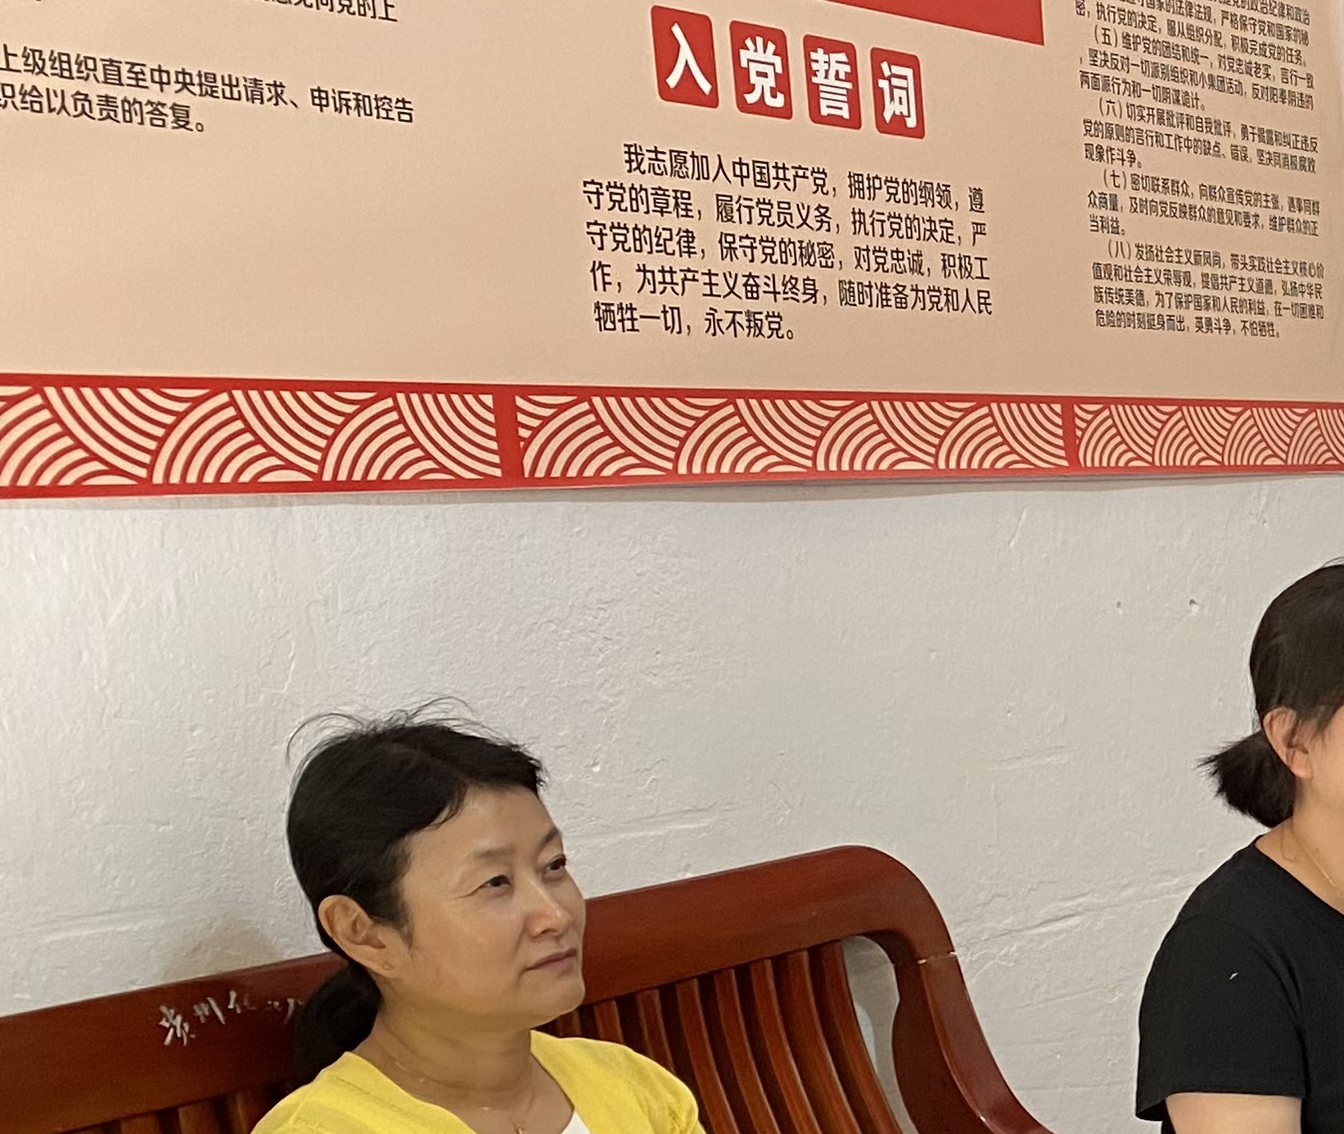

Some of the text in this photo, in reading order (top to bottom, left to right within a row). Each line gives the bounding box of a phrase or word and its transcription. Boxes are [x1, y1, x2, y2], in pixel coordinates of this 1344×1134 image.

[0, 43, 414, 124] 上级组织直至中央提出请求、申诉和控告
[664, 21, 919, 129] 入党誓词
[1079, 70, 1205, 111] 两面派行为和一切阴谋诡计。
[624, 142, 985, 213] 我志愿加入中国共产党，拥护党的纲领，遵
[1084, 143, 1142, 168] 现象作斗争。
[582, 179, 987, 247] 守党的章程，履行党员义务，执行党的决定，严
[1089, 214, 1126, 236] 当利益。
[586, 219, 990, 282] 守党的纪律，保守党的秘密，对党忠诚，积极工
[590, 260, 993, 316] 作，为共产主义奋斗终身，随时准备为党和人民
[594, 301, 795, 342] 牺牲一切，永不叛党。
